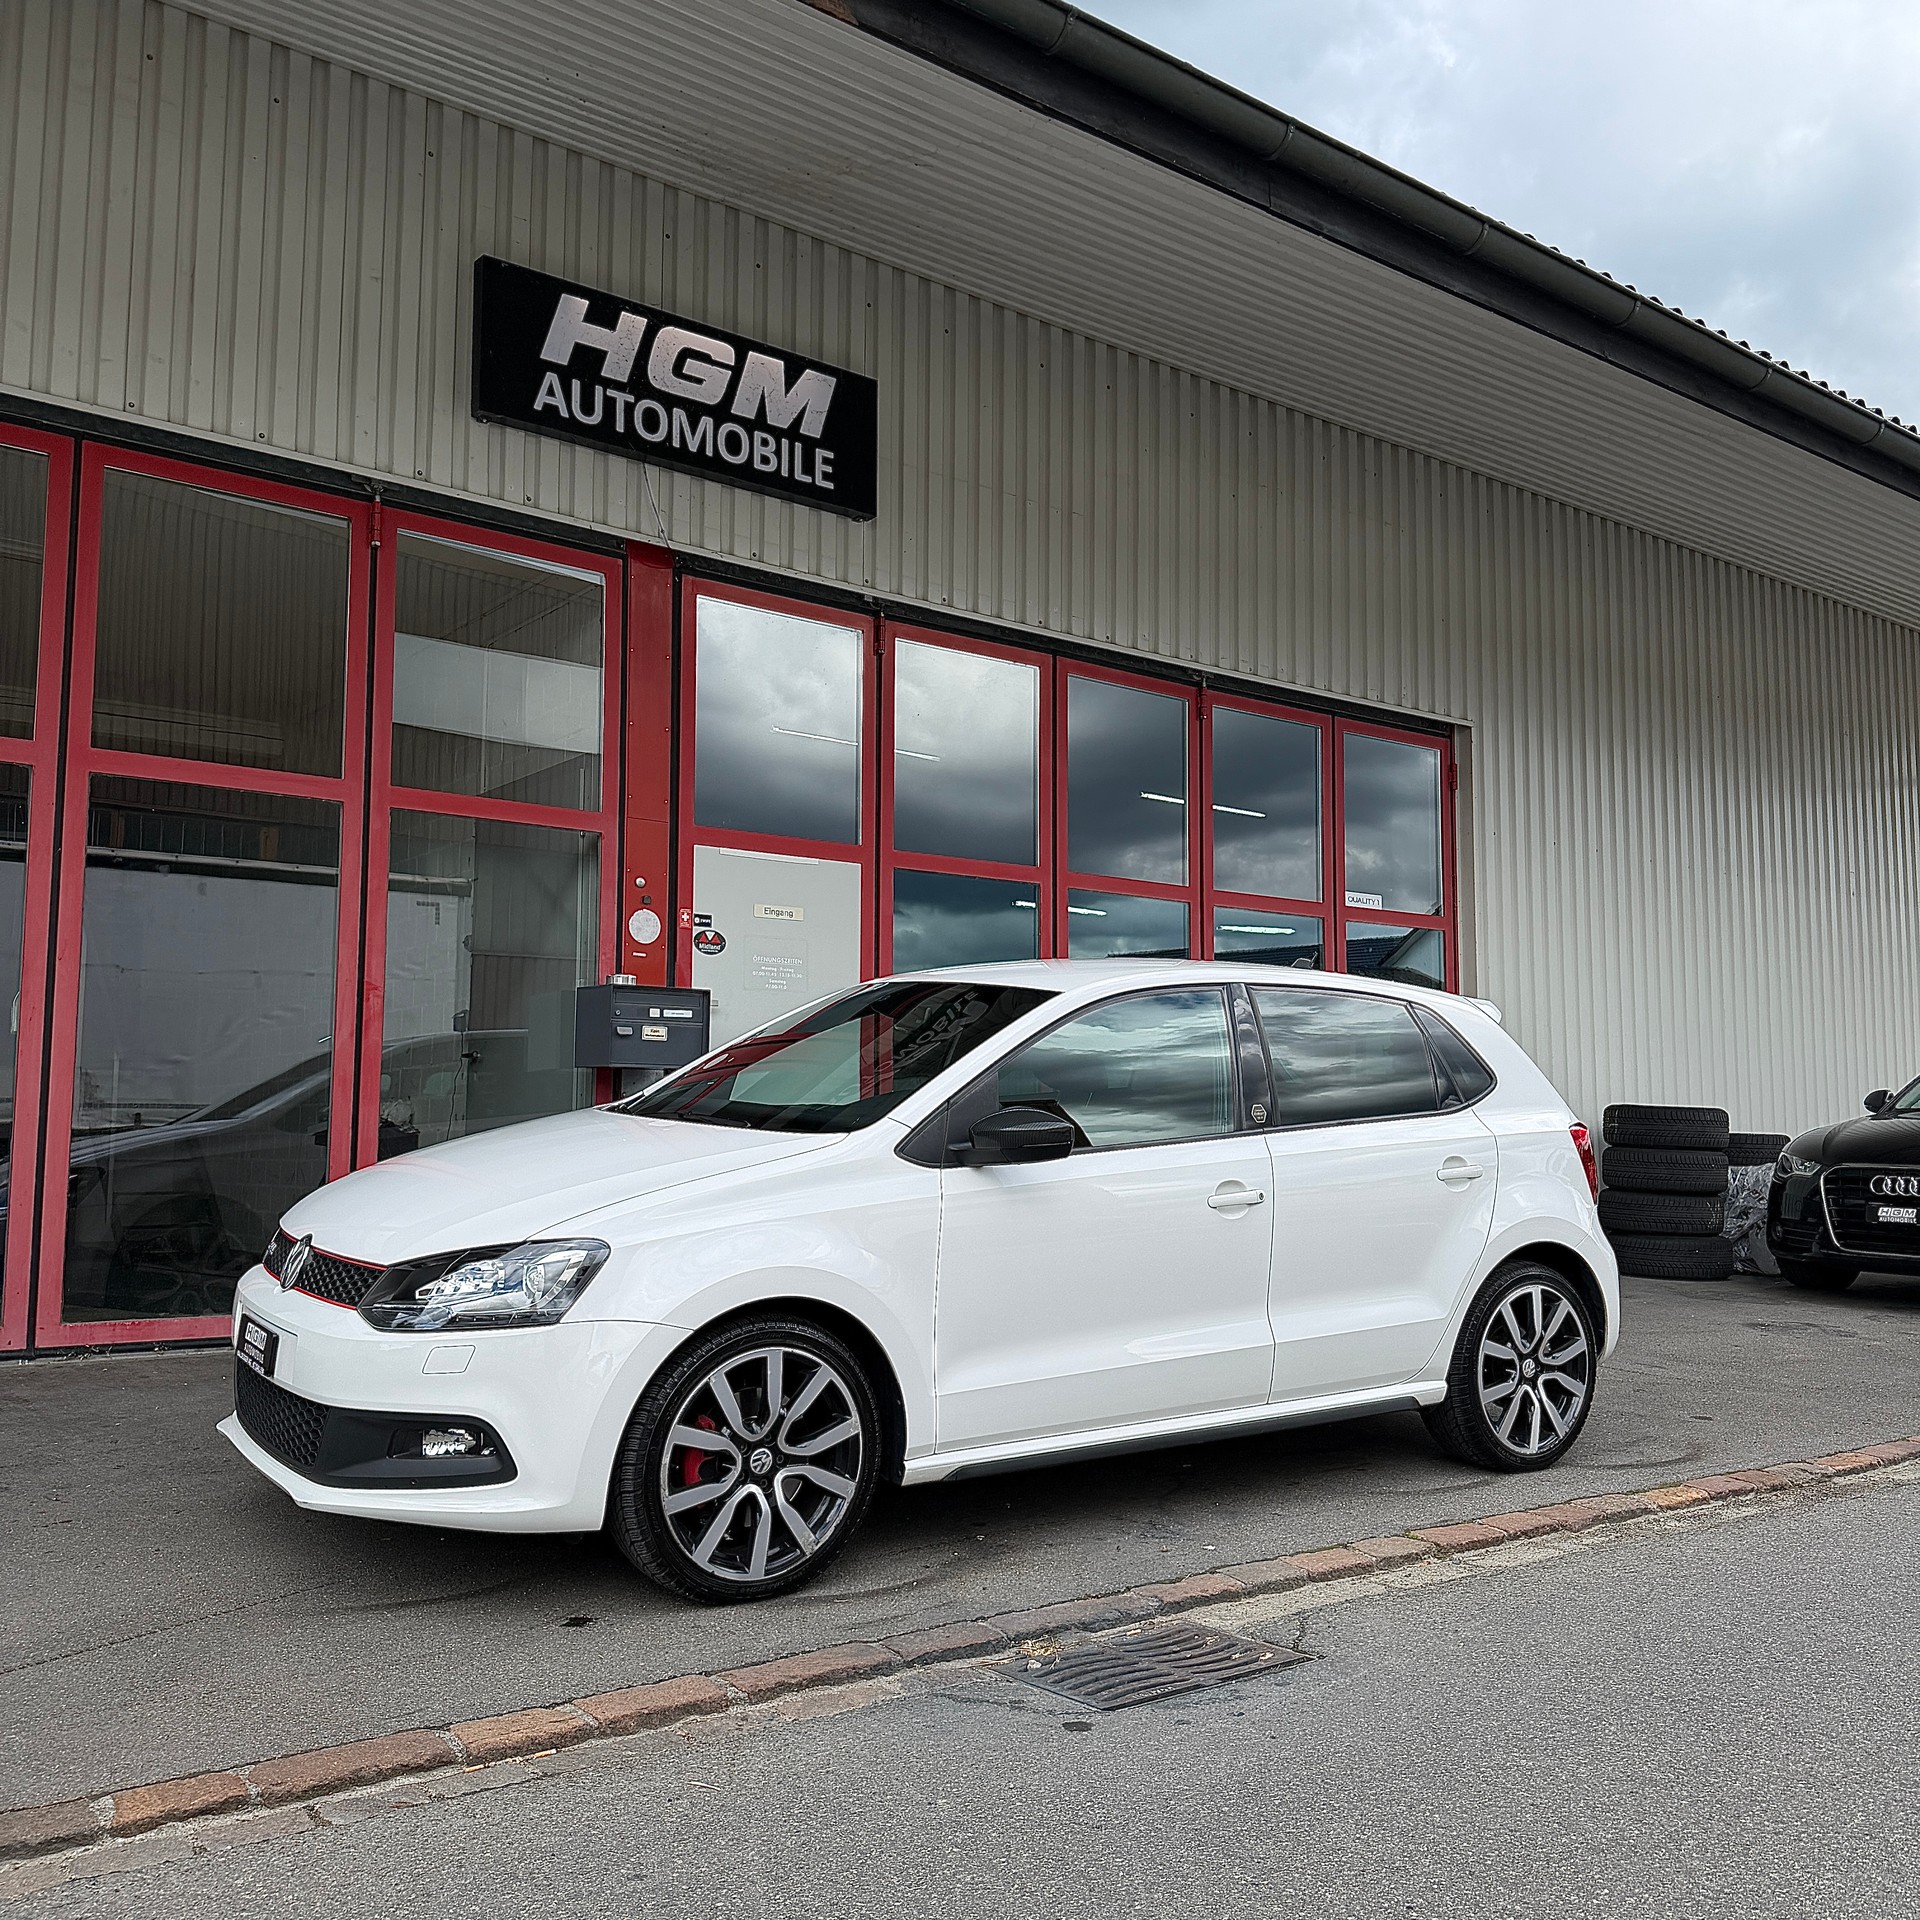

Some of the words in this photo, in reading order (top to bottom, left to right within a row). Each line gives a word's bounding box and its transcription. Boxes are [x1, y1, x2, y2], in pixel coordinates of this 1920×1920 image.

[540, 293, 837, 439] HGM
[533, 371, 835, 490] AUTOMOBILE
[764, 906, 794, 919] Eingang
[752, 955, 803, 965] ÖFFNUNGSZEITEN
[1878, 1207, 1917, 1217] HGM
